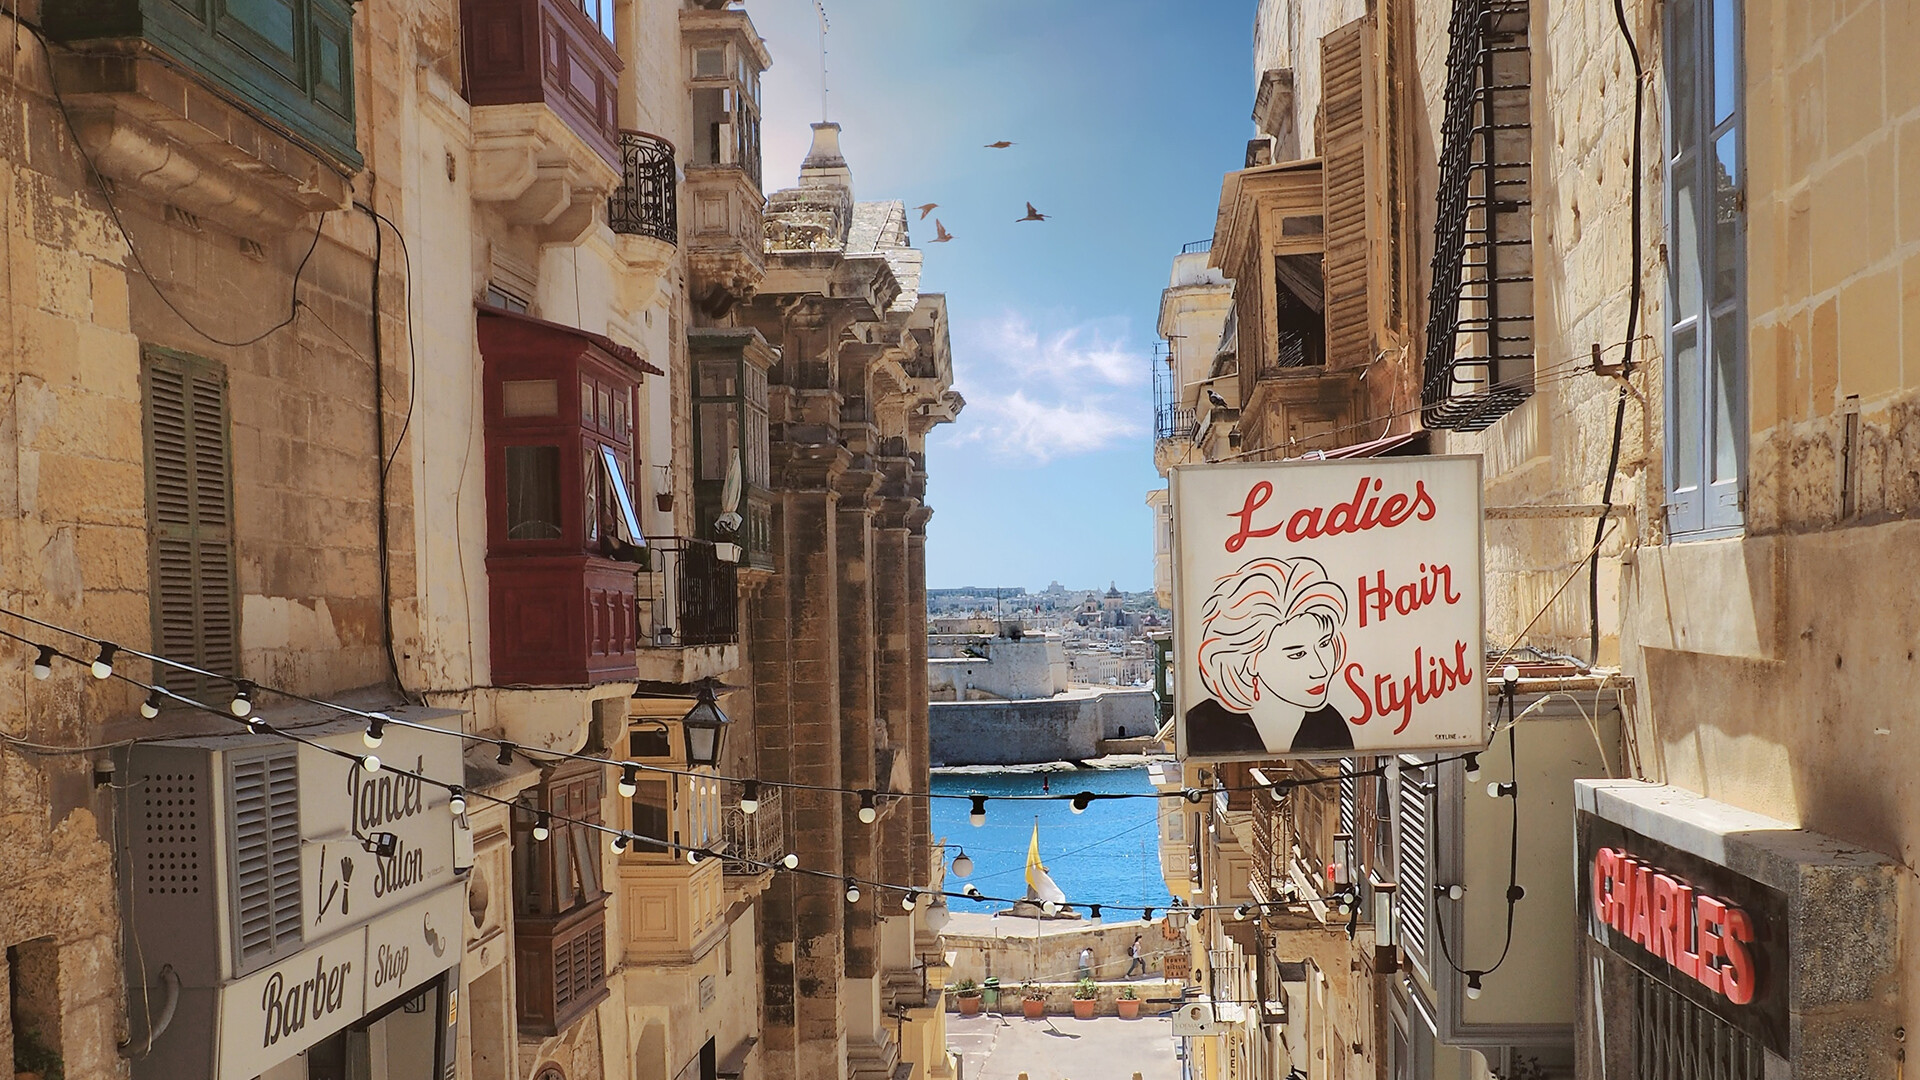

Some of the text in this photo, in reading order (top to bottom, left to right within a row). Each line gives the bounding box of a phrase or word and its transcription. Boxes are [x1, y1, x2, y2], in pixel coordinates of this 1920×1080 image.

[1225, 477, 1437, 553] Ladies
[1358, 562, 1462, 628] Hair
[1344, 639, 1473, 735] Stylist
[374, 839, 423, 898] Salon
[1593, 847, 1755, 1005] CHARLES
[262, 955, 352, 1049] Barber
[374, 943, 409, 989] Shop
